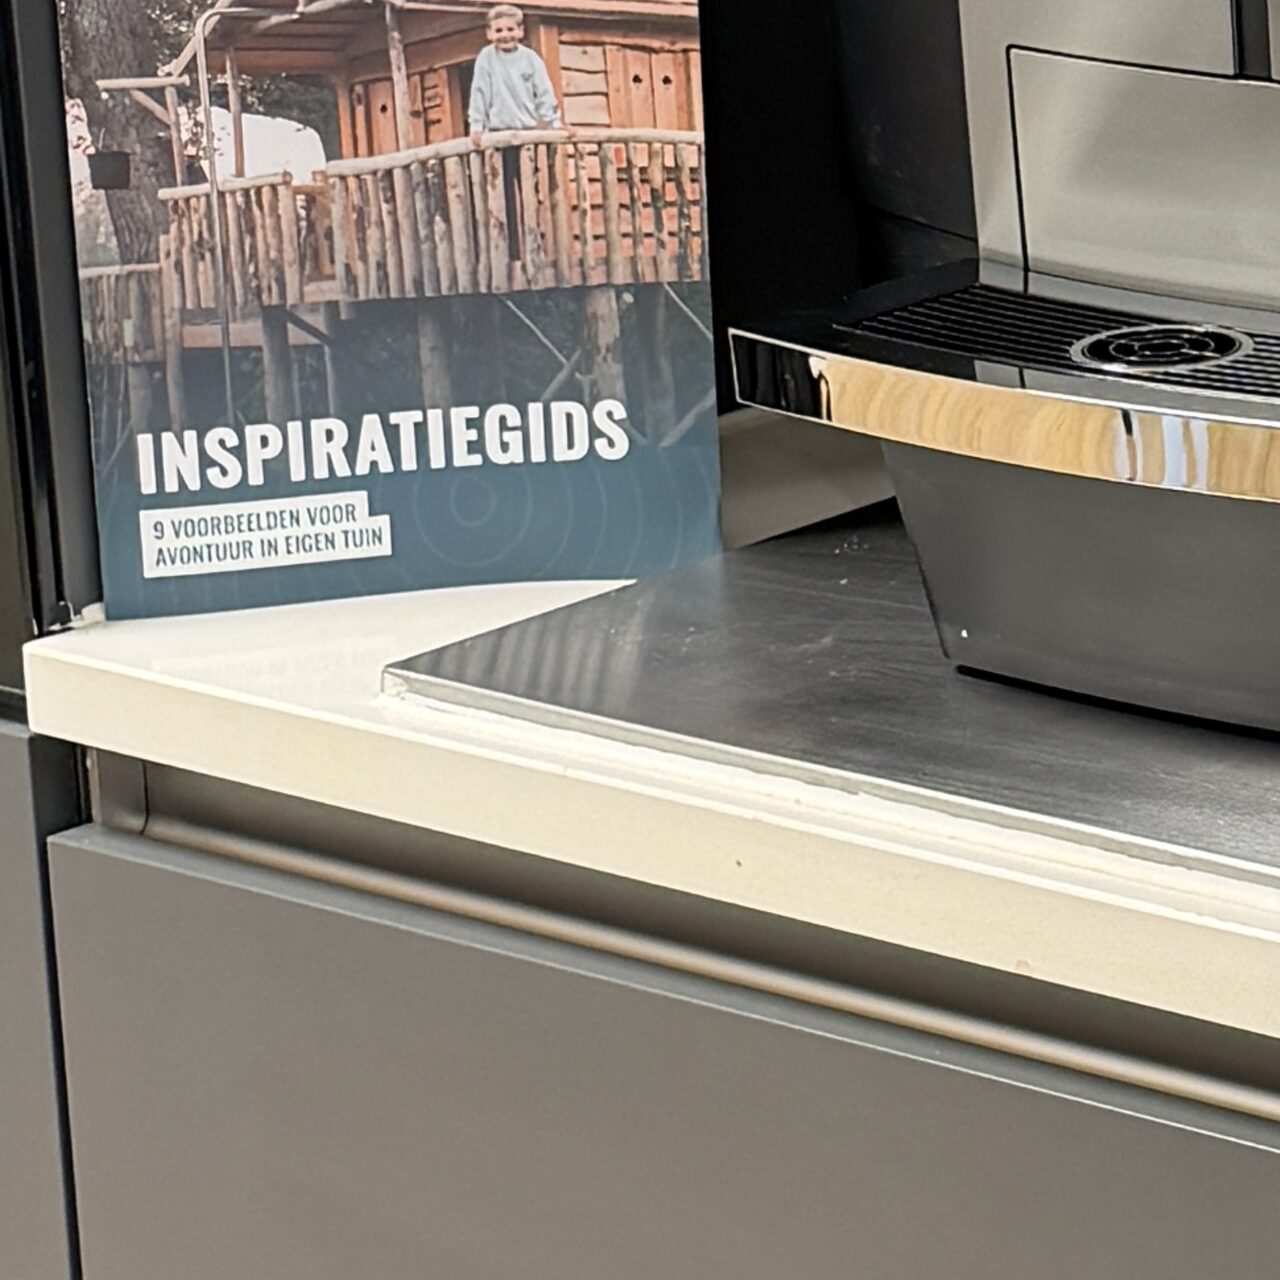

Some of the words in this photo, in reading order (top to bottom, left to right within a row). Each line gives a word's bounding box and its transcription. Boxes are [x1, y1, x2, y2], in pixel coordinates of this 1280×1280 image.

[137, 399, 630, 495] INSPIRATIEGIDS
[153, 521, 165, 540] 9
[171, 509, 300, 539] VOORBEELDEN
[306, 503, 357, 525] VOOR
[155, 540, 254, 567] AVONTUUR
[260, 537, 279, 558] IN
[285, 532, 336, 555] EIGEN
[341, 527, 384, 548] TUIN
